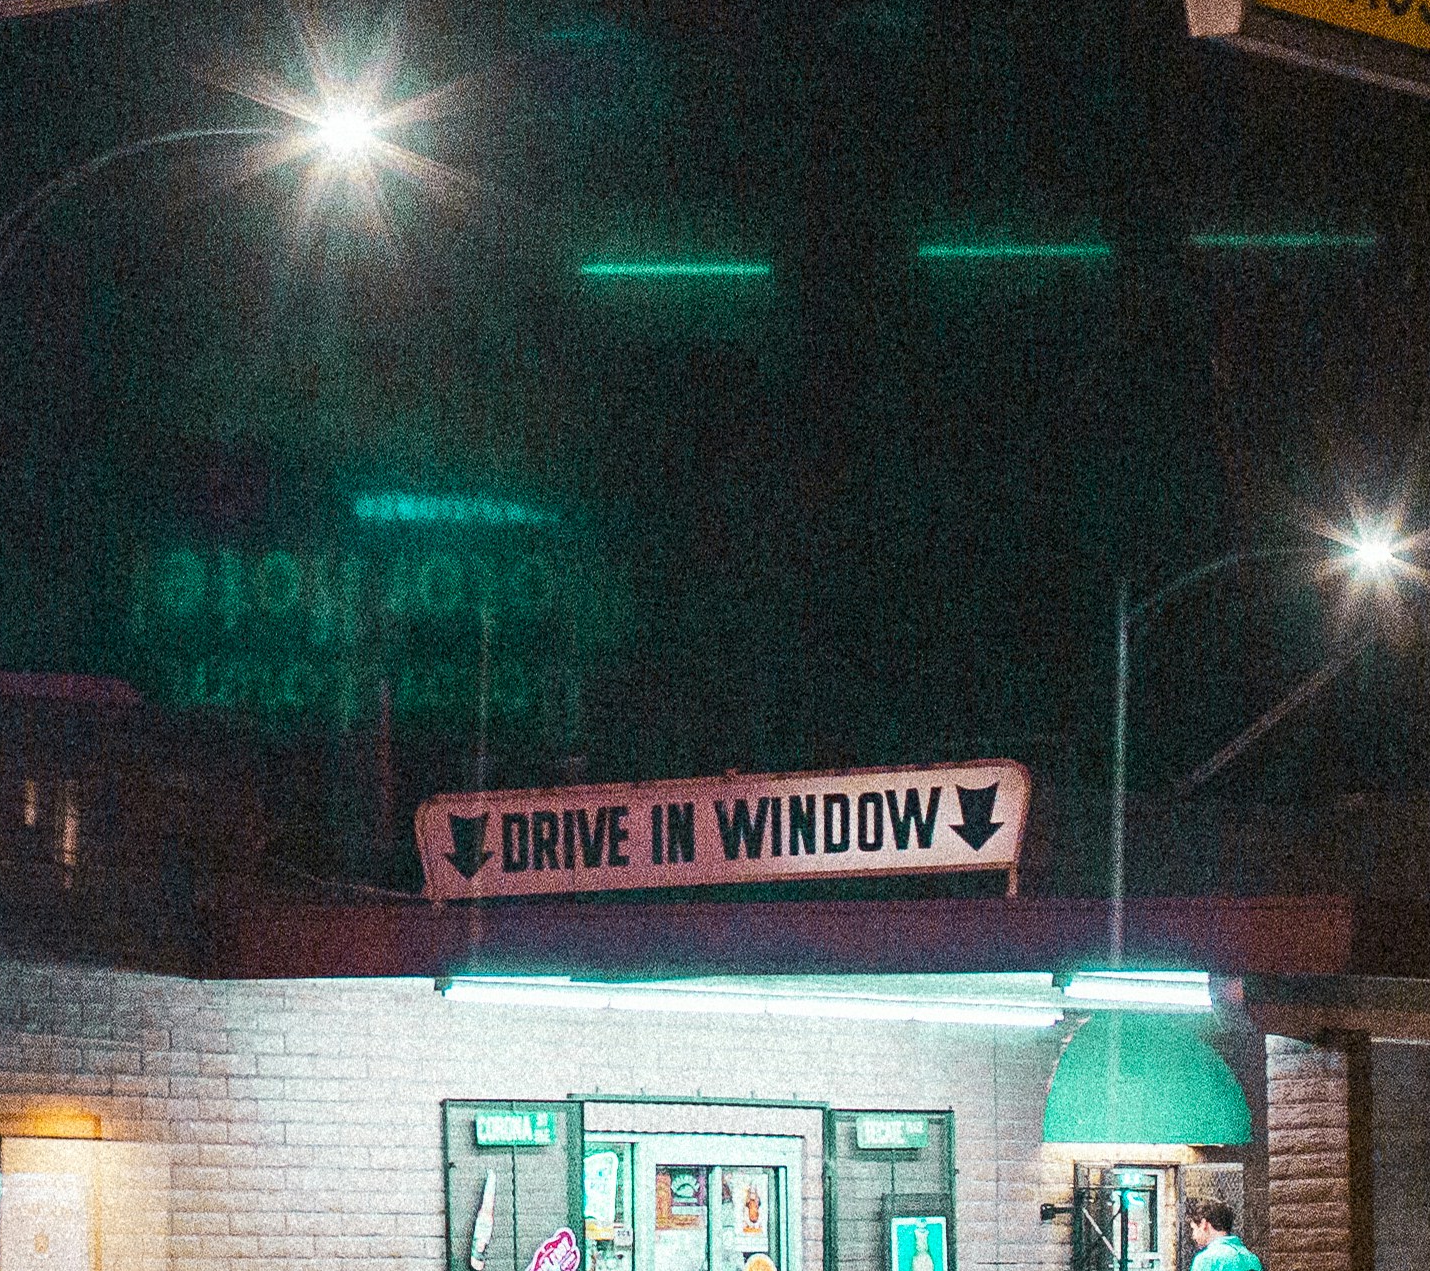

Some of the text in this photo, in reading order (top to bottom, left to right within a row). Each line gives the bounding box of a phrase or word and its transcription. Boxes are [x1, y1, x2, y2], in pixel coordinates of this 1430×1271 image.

[501, 786, 943, 874] DRIVE IN WINDOW
